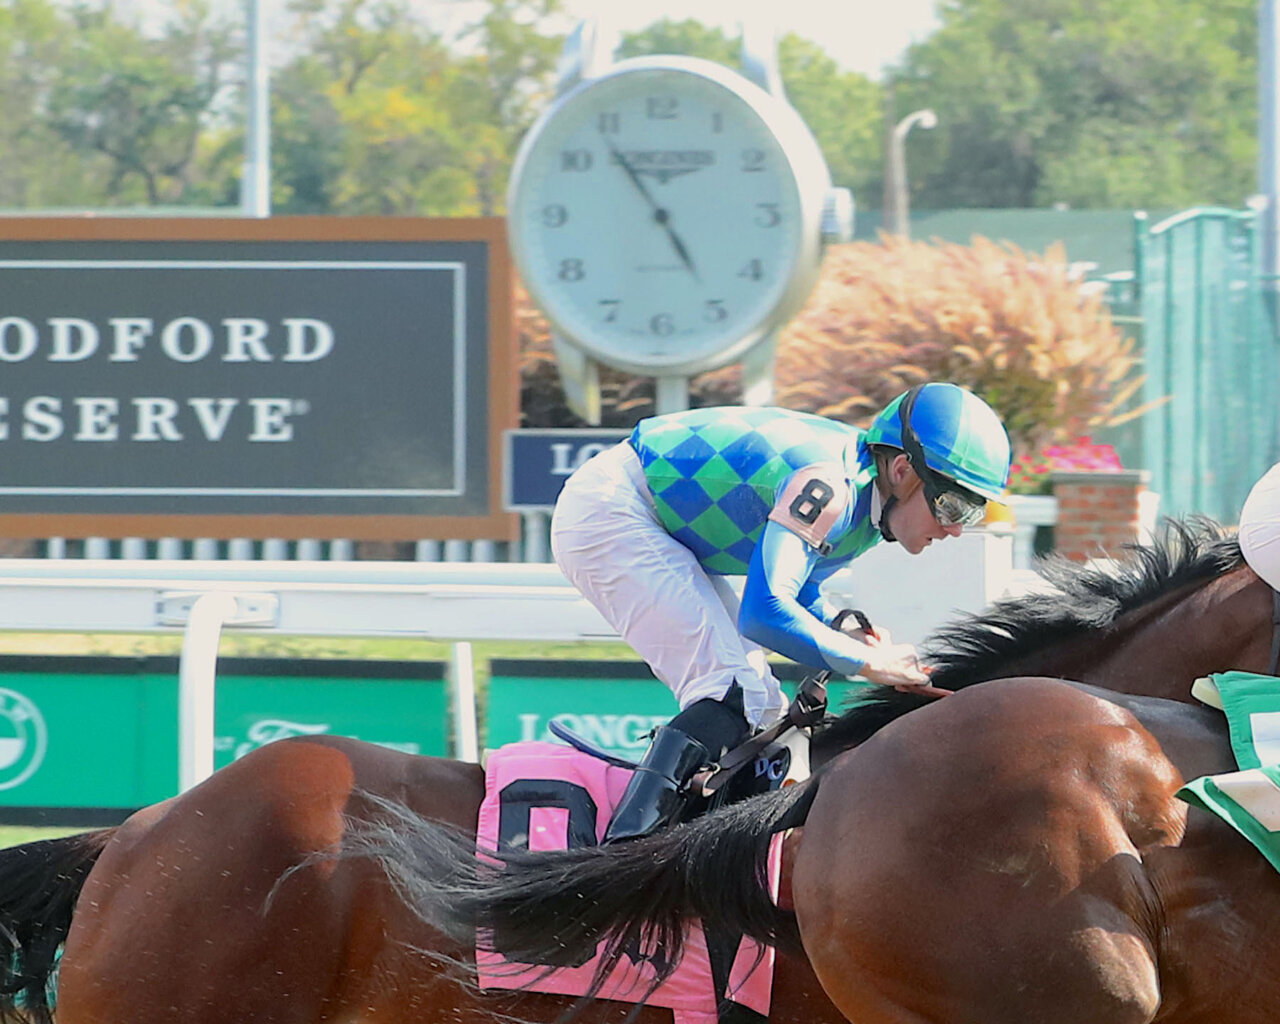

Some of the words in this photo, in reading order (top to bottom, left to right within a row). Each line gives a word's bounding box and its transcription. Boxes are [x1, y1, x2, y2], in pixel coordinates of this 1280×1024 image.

[647, 97, 678, 119] 12
[560, 150, 593, 172] 10
[741, 150, 766, 172] 2
[542, 204, 568, 228] 9
[754, 204, 781, 228] 3
[558, 258, 586, 282] 8
[738, 258, 764, 282] 4
[600, 299, 622, 323] 7
[650, 313, 675, 336] 6
[0, 396, 294, 442] SERVE
[788, 478, 835, 525] 8
[754, 757, 783, 782] DC
